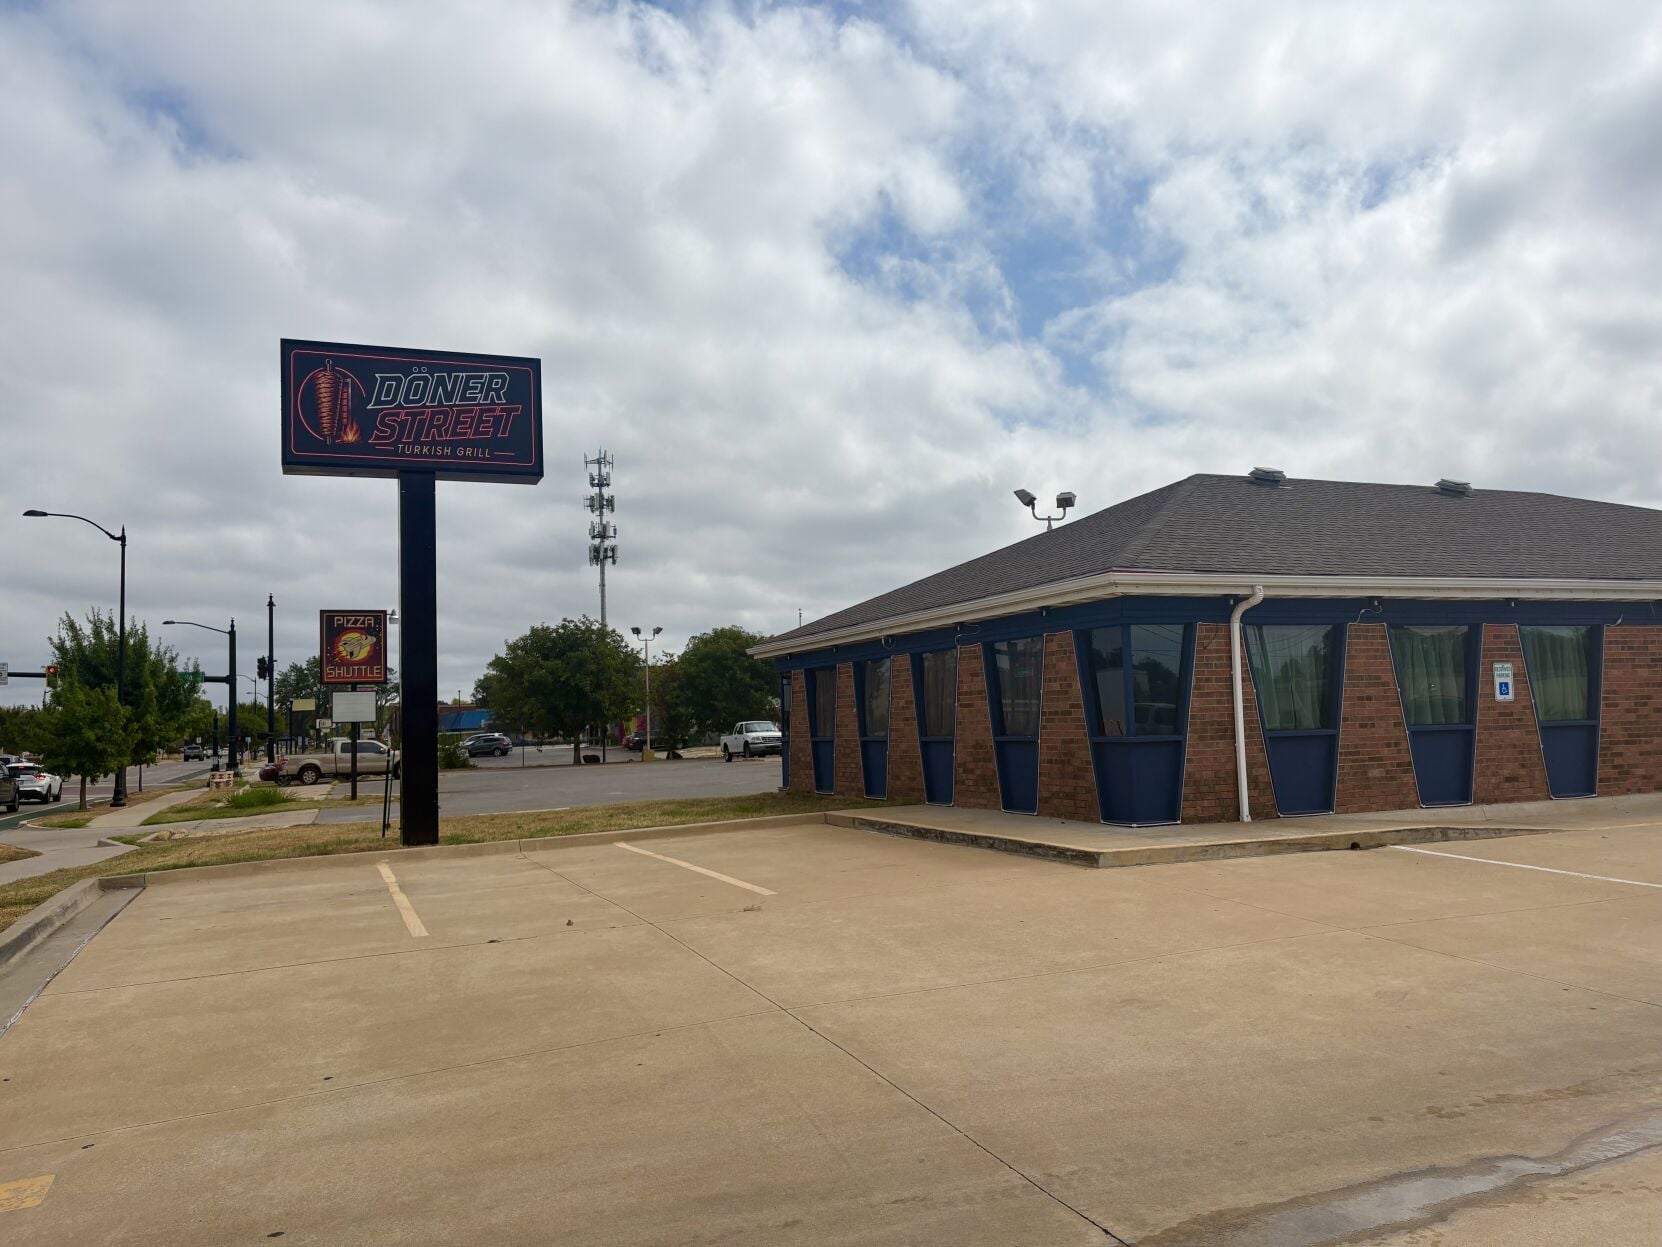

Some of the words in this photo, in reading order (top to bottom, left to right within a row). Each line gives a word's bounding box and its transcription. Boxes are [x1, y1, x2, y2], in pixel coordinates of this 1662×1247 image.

[367, 366, 510, 409] DÖNER
[368, 405, 522, 443] STREET
[397, 444, 451, 456] TURKISH
[456, 447, 491, 458] GRILL
[334, 616, 374, 628] PIZZA
[326, 665, 382, 678] SHUTTLE
